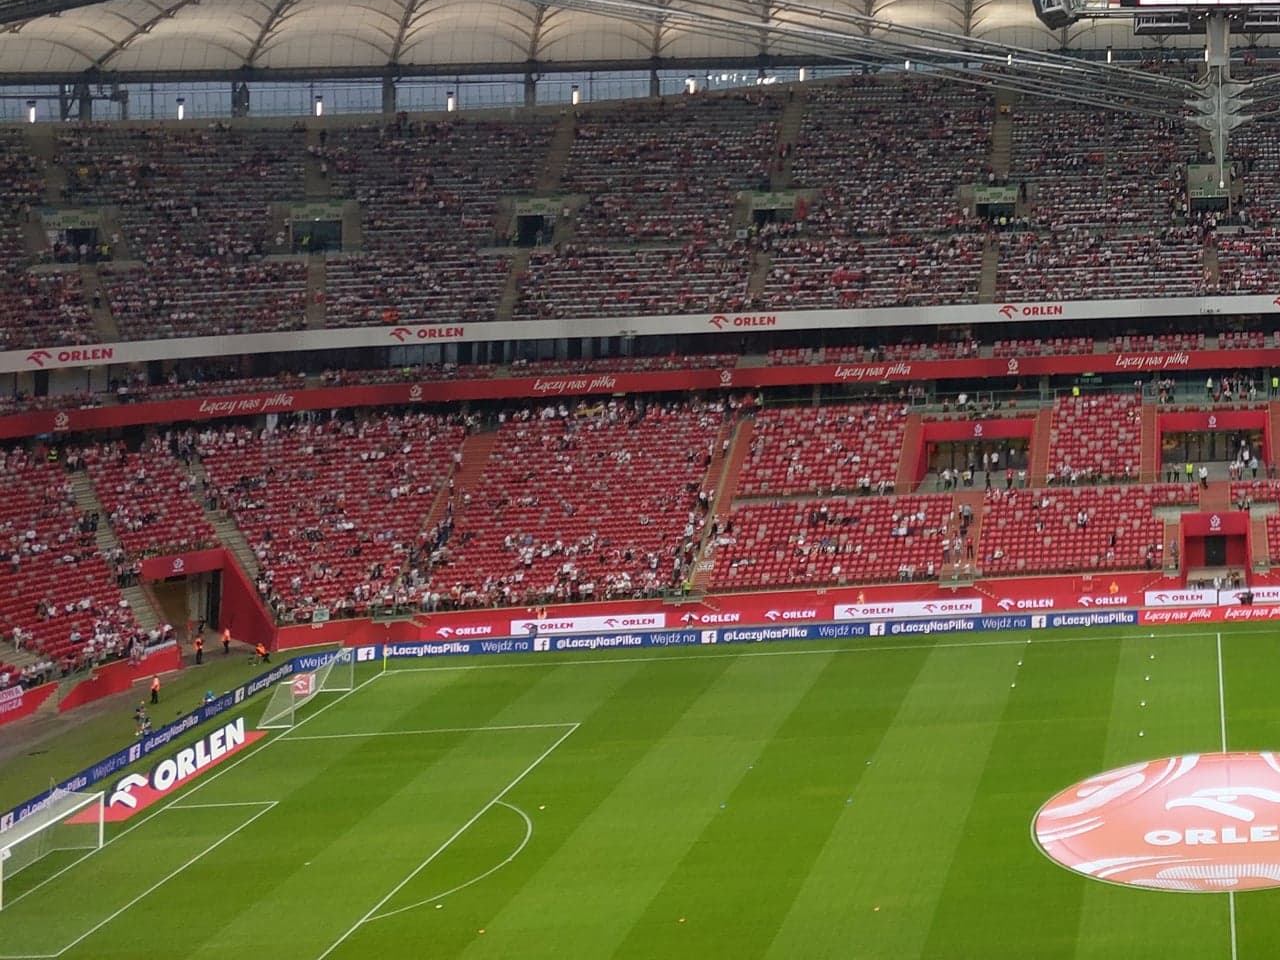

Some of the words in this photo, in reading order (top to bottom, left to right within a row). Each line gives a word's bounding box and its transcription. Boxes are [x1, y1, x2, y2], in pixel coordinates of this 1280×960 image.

[1023, 306, 1062, 316] ORLEN
[734, 316, 776, 326] ORLEN
[417, 327, 464, 339] ORLEN
[58, 348, 112, 361] ORLEN
[1116, 354, 1144, 368] Łączy
[1146, 355, 1162, 365] nas
[1165, 353, 1188, 367] piłka
[834, 366, 863, 380] Łączy
[866, 366, 884, 376] nas
[887, 362, 911, 376] piłka
[534, 378, 565, 392] Łączy
[568, 378, 587, 388] nas
[590, 376, 615, 391] piłka
[200, 398, 235, 415] Łączy
[239, 397, 260, 408] nas
[263, 393, 293, 409] piłka
[1095, 596, 1128, 605] ORLEN
[1172, 593, 1202, 601] ORLEN
[1017, 599, 1054, 608] ORLEN
[783, 610, 816, 620] ORLEN
[862, 606, 894, 615] ORLEN
[702, 613, 739, 623] ORLEN
[540, 622, 573, 630] ORLEN
[1014, 619, 1025, 628] na
[456, 626, 492, 636] ORLEN
[852, 626, 864, 635] na
[684, 634, 695, 643] na
[517, 642, 528, 650] na
[152, 717, 245, 790] ORLEN
